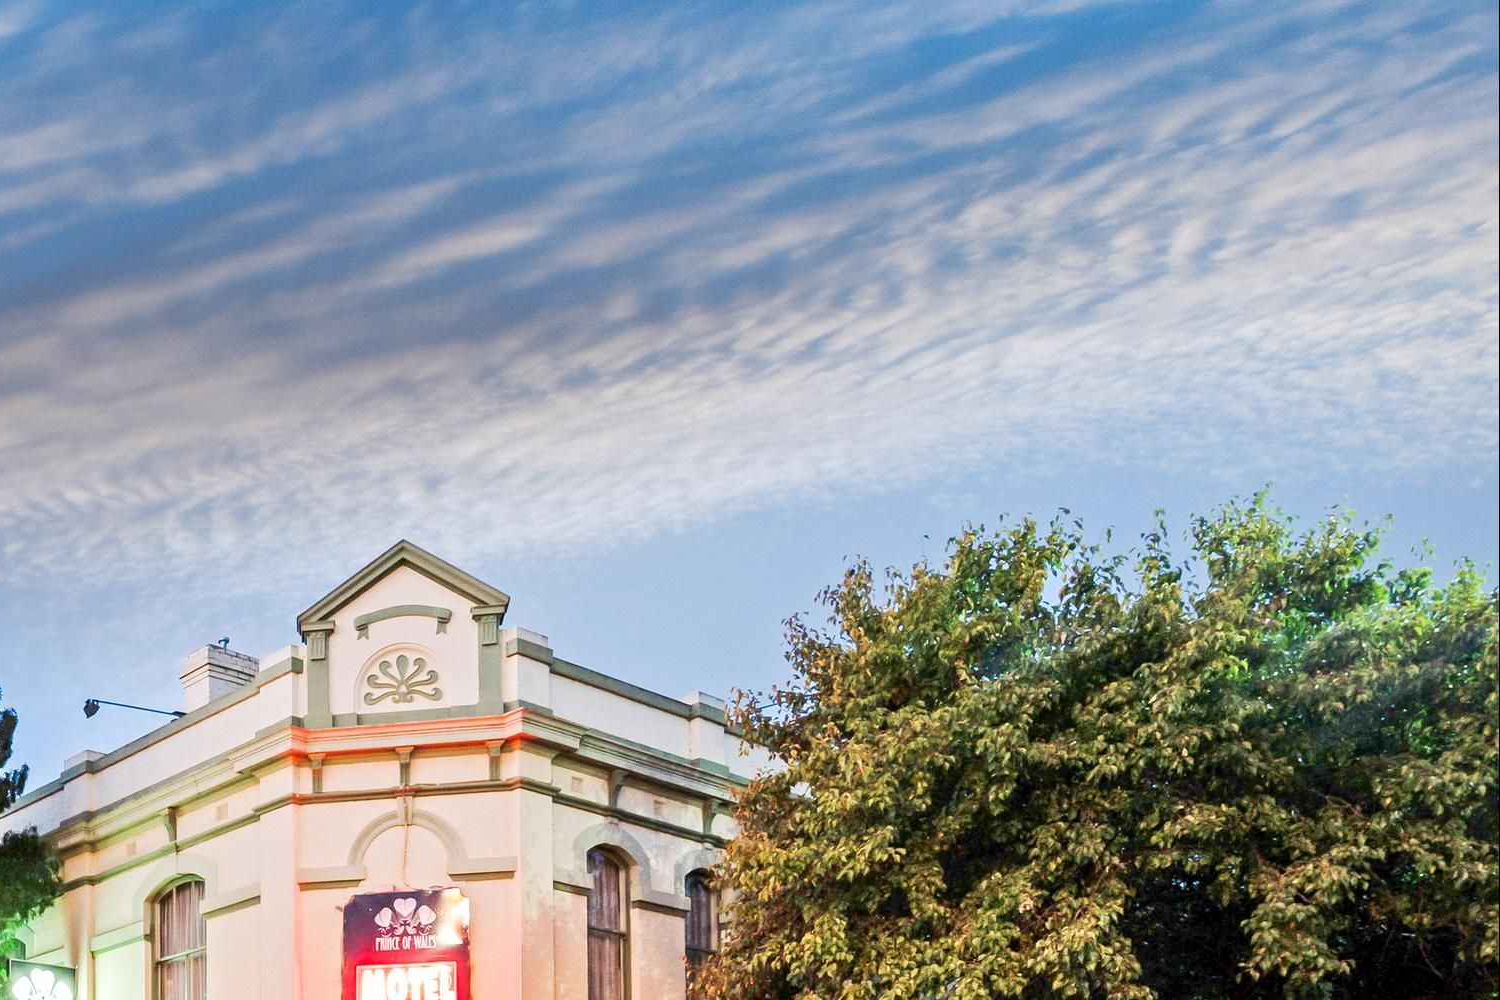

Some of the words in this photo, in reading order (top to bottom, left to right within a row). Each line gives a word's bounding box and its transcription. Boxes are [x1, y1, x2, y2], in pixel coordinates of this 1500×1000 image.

[375, 936, 400, 951] PRINCE
[402, 936, 412, 949] OF
[414, 934, 437, 949] WALES
